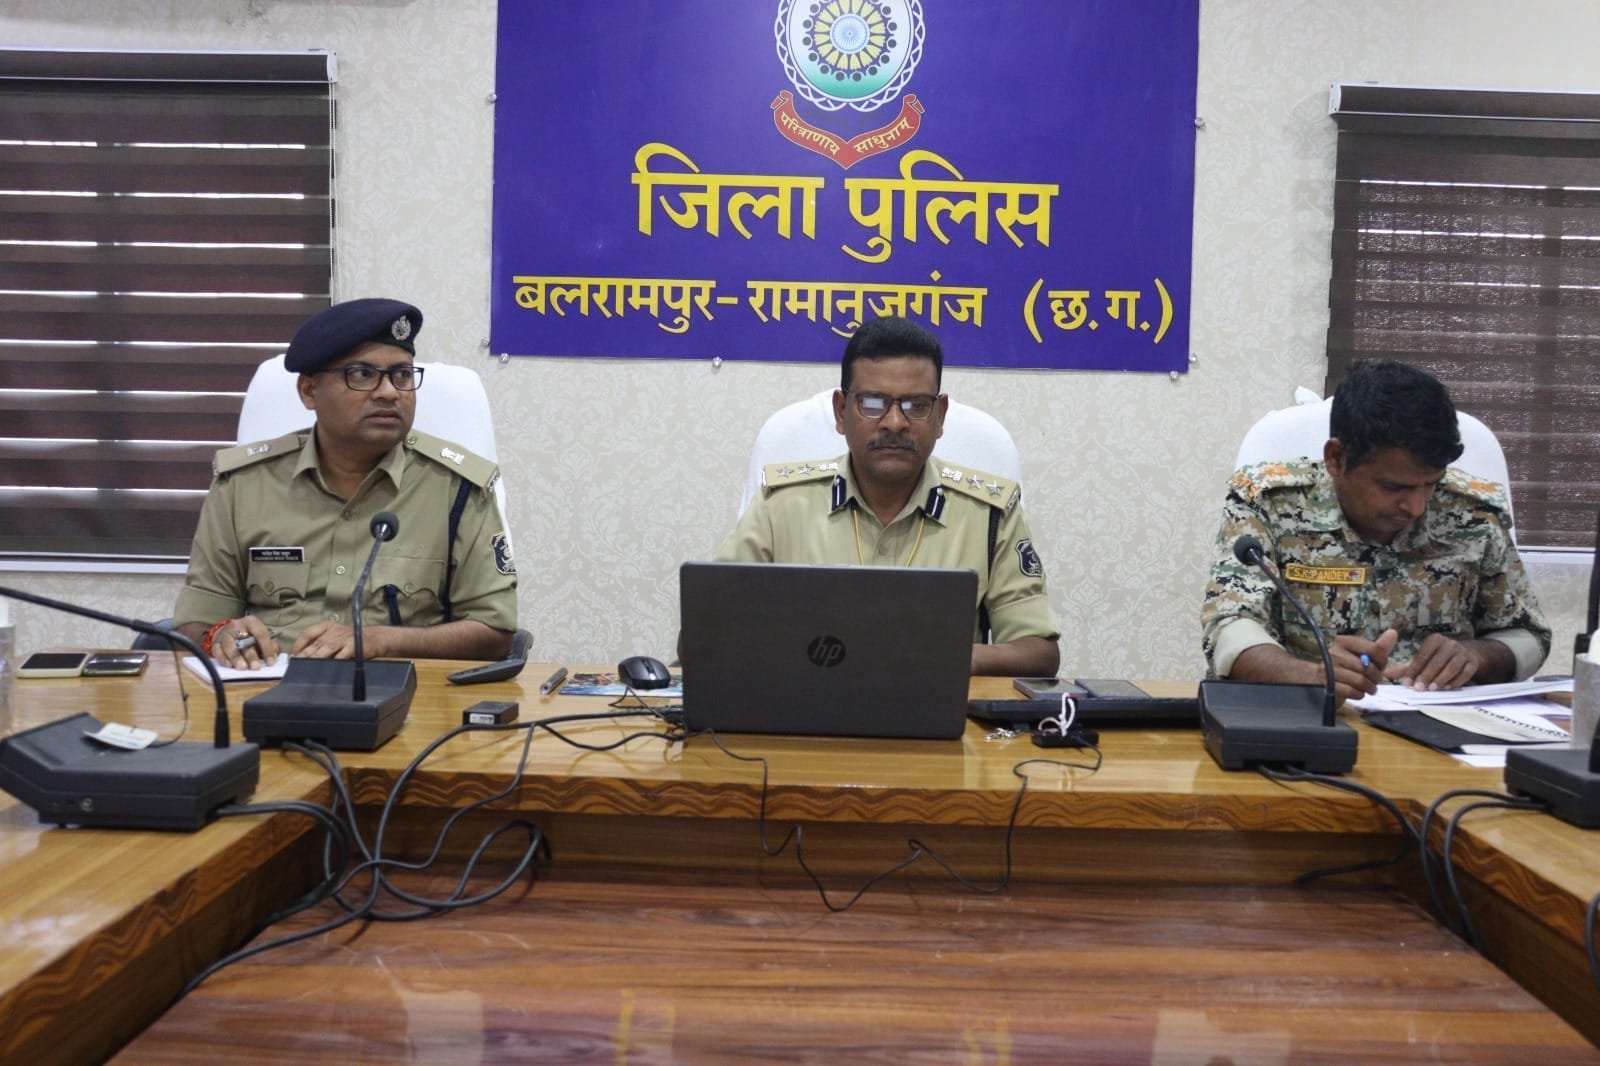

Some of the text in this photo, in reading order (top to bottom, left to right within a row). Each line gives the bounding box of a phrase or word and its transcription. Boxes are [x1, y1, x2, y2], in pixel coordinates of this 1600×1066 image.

[780, 111, 841, 156] परित्राणाय
[631, 142, 1060, 263] जिला पुलिस
[810, 635, 844, 668] hp
